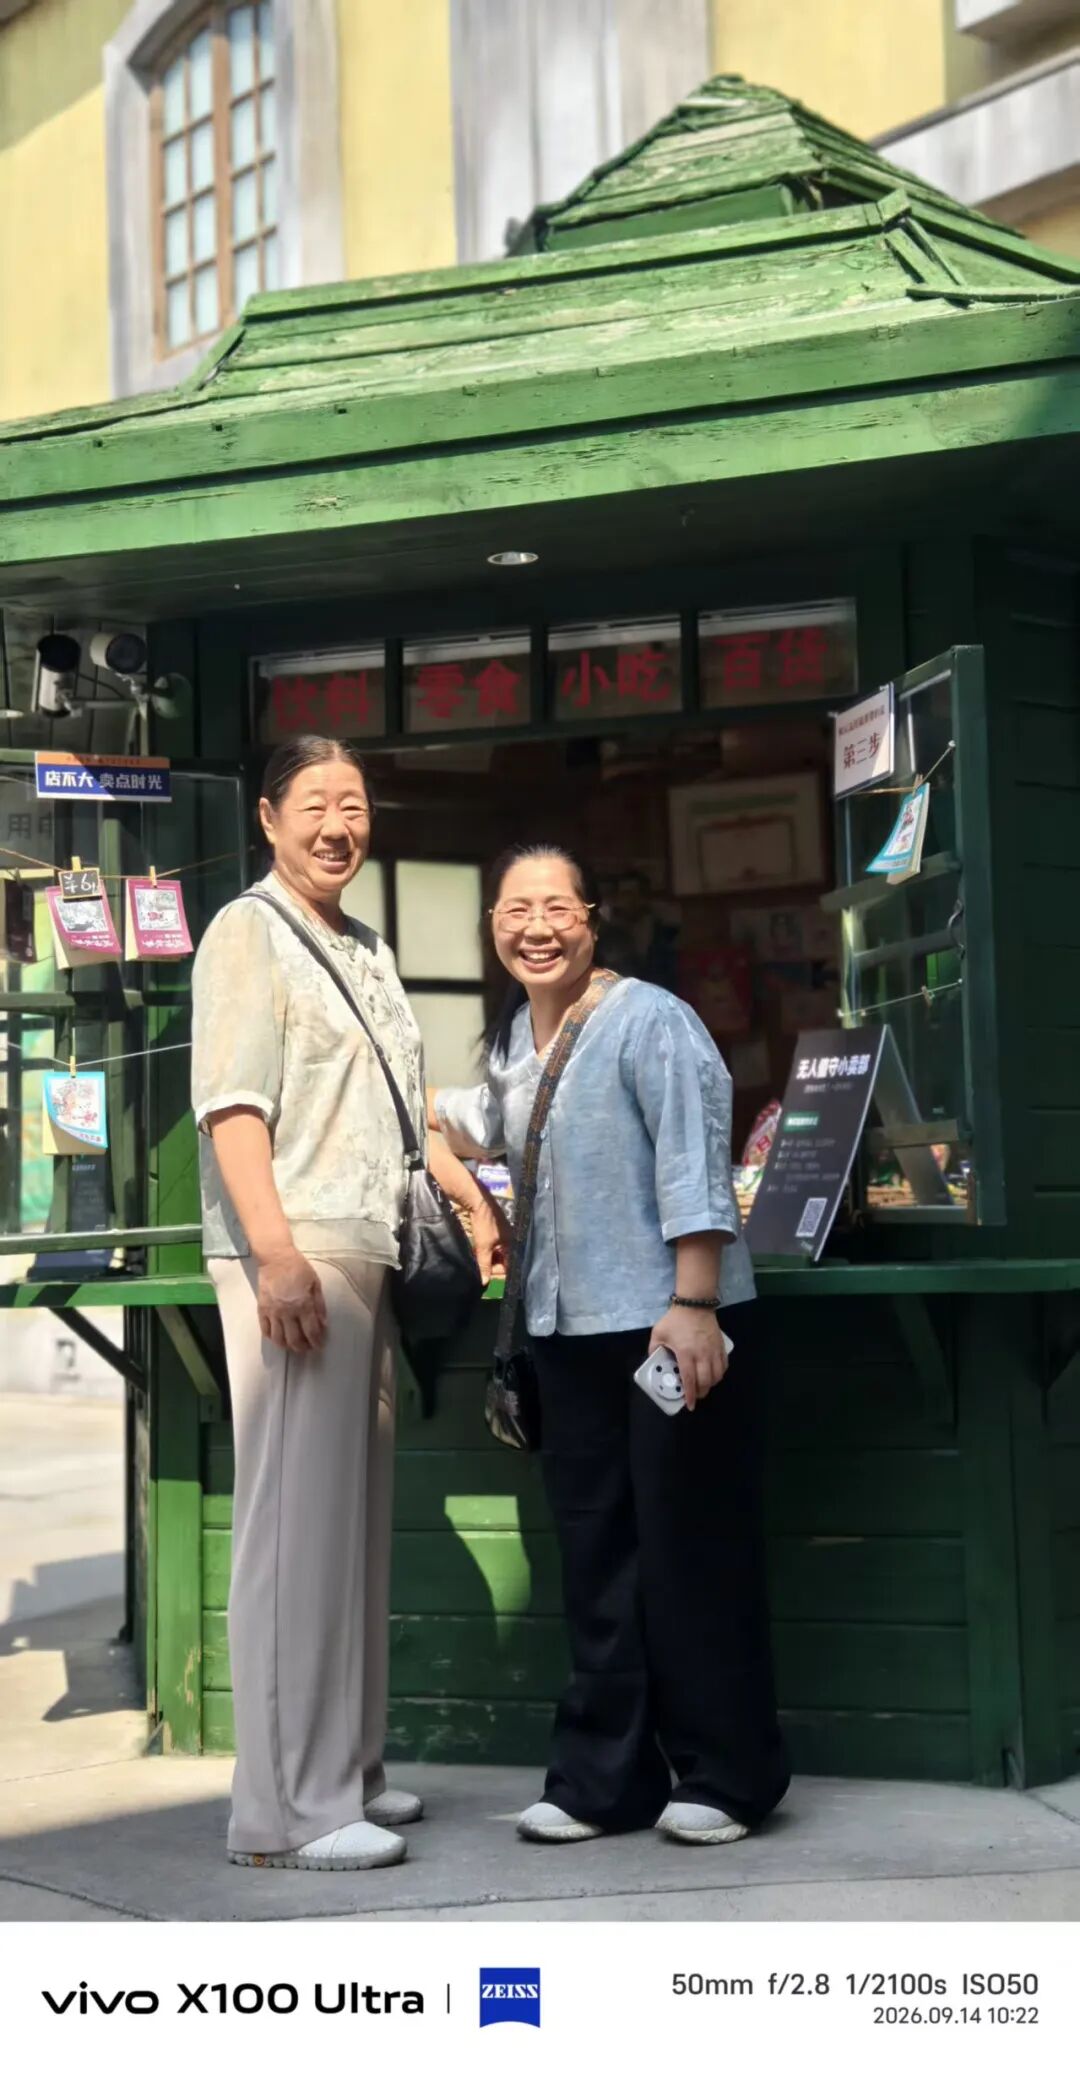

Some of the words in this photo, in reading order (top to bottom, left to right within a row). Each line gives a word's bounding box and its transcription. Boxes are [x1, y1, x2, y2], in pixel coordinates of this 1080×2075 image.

[271, 668, 371, 730] 饮料
[416, 659, 522, 719] 零食
[560, 649, 672, 707] 小吃
[713, 625, 828, 690] 百货
[843, 731, 882, 770] 第三步
[45, 770, 94, 788] 店不大
[100, 772, 163, 790] 卖点时光
[796, 1054, 871, 1079] 无人值守小卖部
